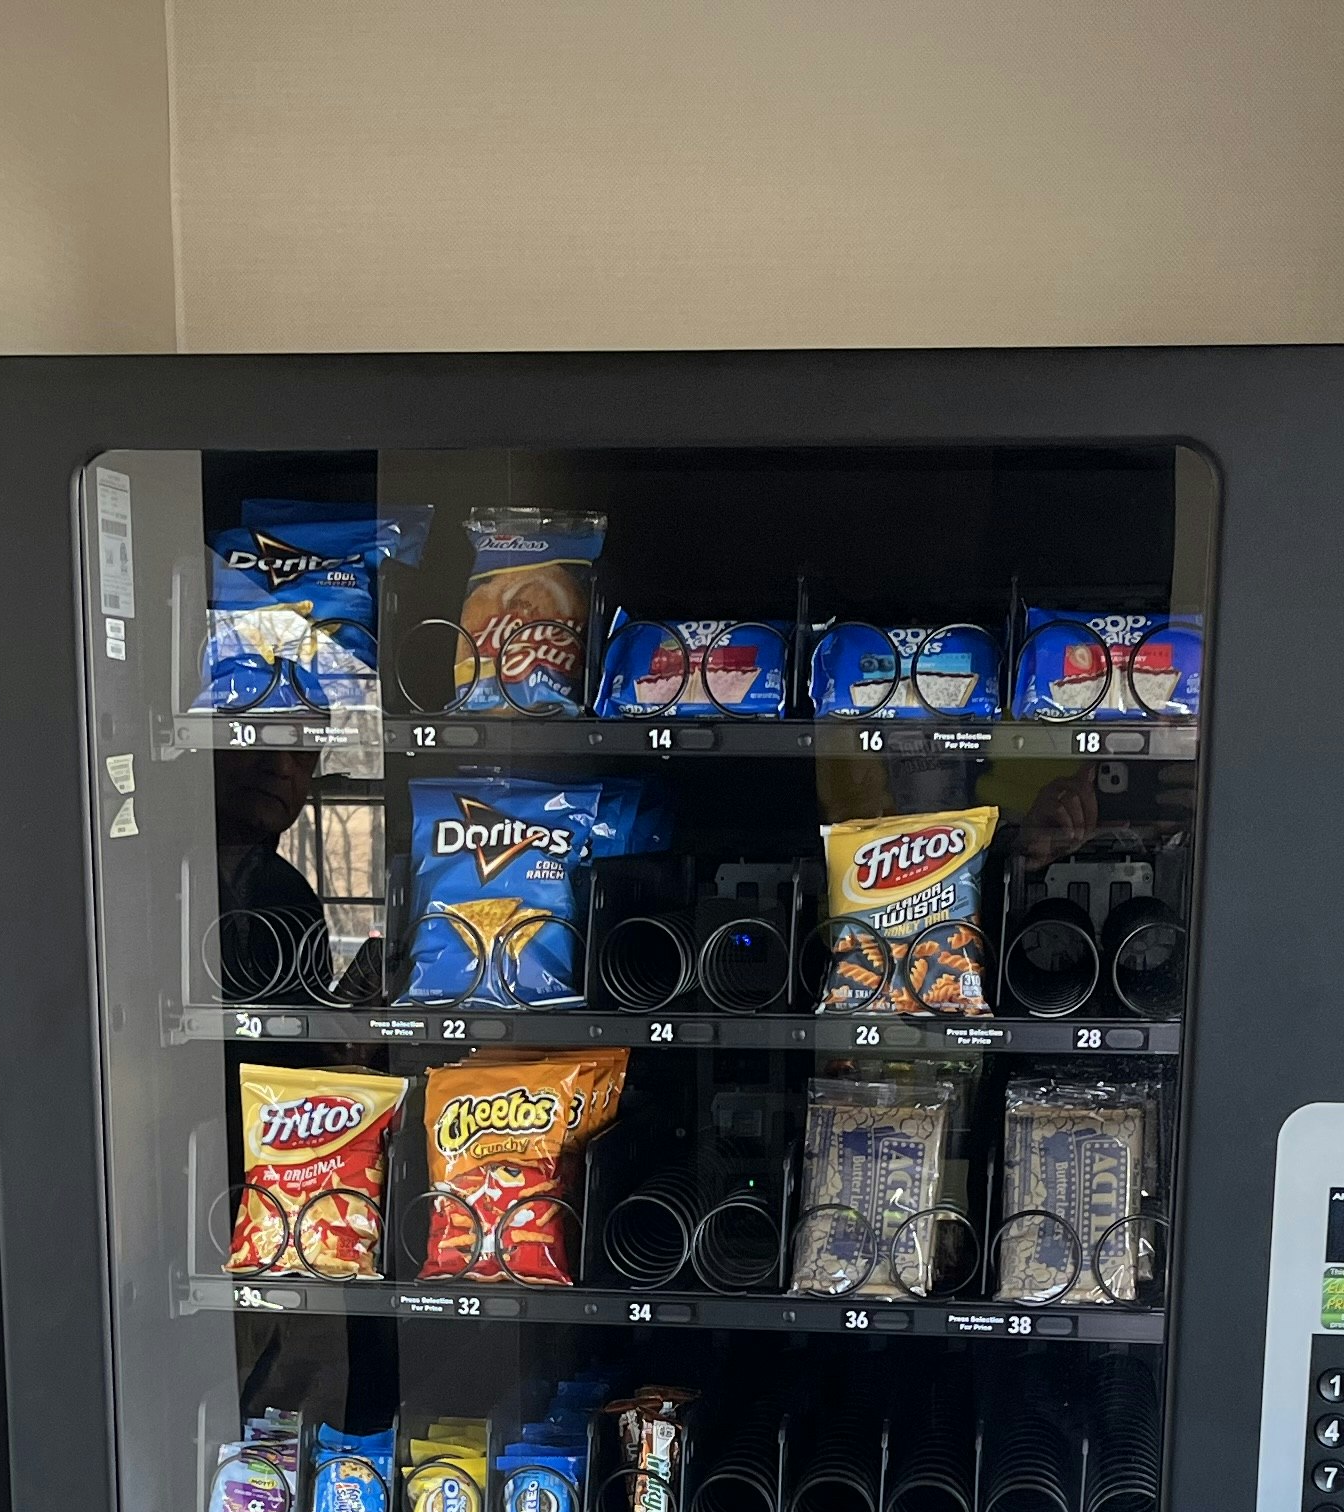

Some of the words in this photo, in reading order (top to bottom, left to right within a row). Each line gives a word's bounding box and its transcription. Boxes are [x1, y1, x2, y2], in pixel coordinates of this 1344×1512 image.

[232, 726, 256, 746] 10
[413, 727, 436, 746] 12
[649, 729, 672, 748] 14
[859, 731, 883, 750] 16
[1076, 732, 1100, 753] 18
[437, 819, 572, 854] Doritos
[854, 828, 965, 889] Fritos
[870, 884, 955, 929] TWISTS
[886, 882, 942, 914] FLAVOR
[236, 1016, 262, 1038] 20
[442, 1019, 465, 1039] 22
[650, 1023, 674, 1041] 24
[856, 1026, 880, 1045] 26
[1077, 1030, 1101, 1048] 28
[259, 1098, 364, 1145] Fritos
[438, 1095, 553, 1150] Cheetos
[470, 1138, 531, 1159] Crunchy
[283, 1155, 345, 1181] ORIGINAL
[852, 1155, 866, 1194] Butter
[1055, 1162, 1068, 1200] Butter
[1091, 1153, 1118, 1210] ACT
[458, 1298, 480, 1315] 32
[629, 1304, 651, 1321] 34
[845, 1311, 869, 1329] 36
[1008, 1316, 1032, 1334] 38
[1329, 1374, 1342, 1397] 1
[1324, 1420, 1340, 1441] 4
[1323, 1467, 1338, 1489] 7
